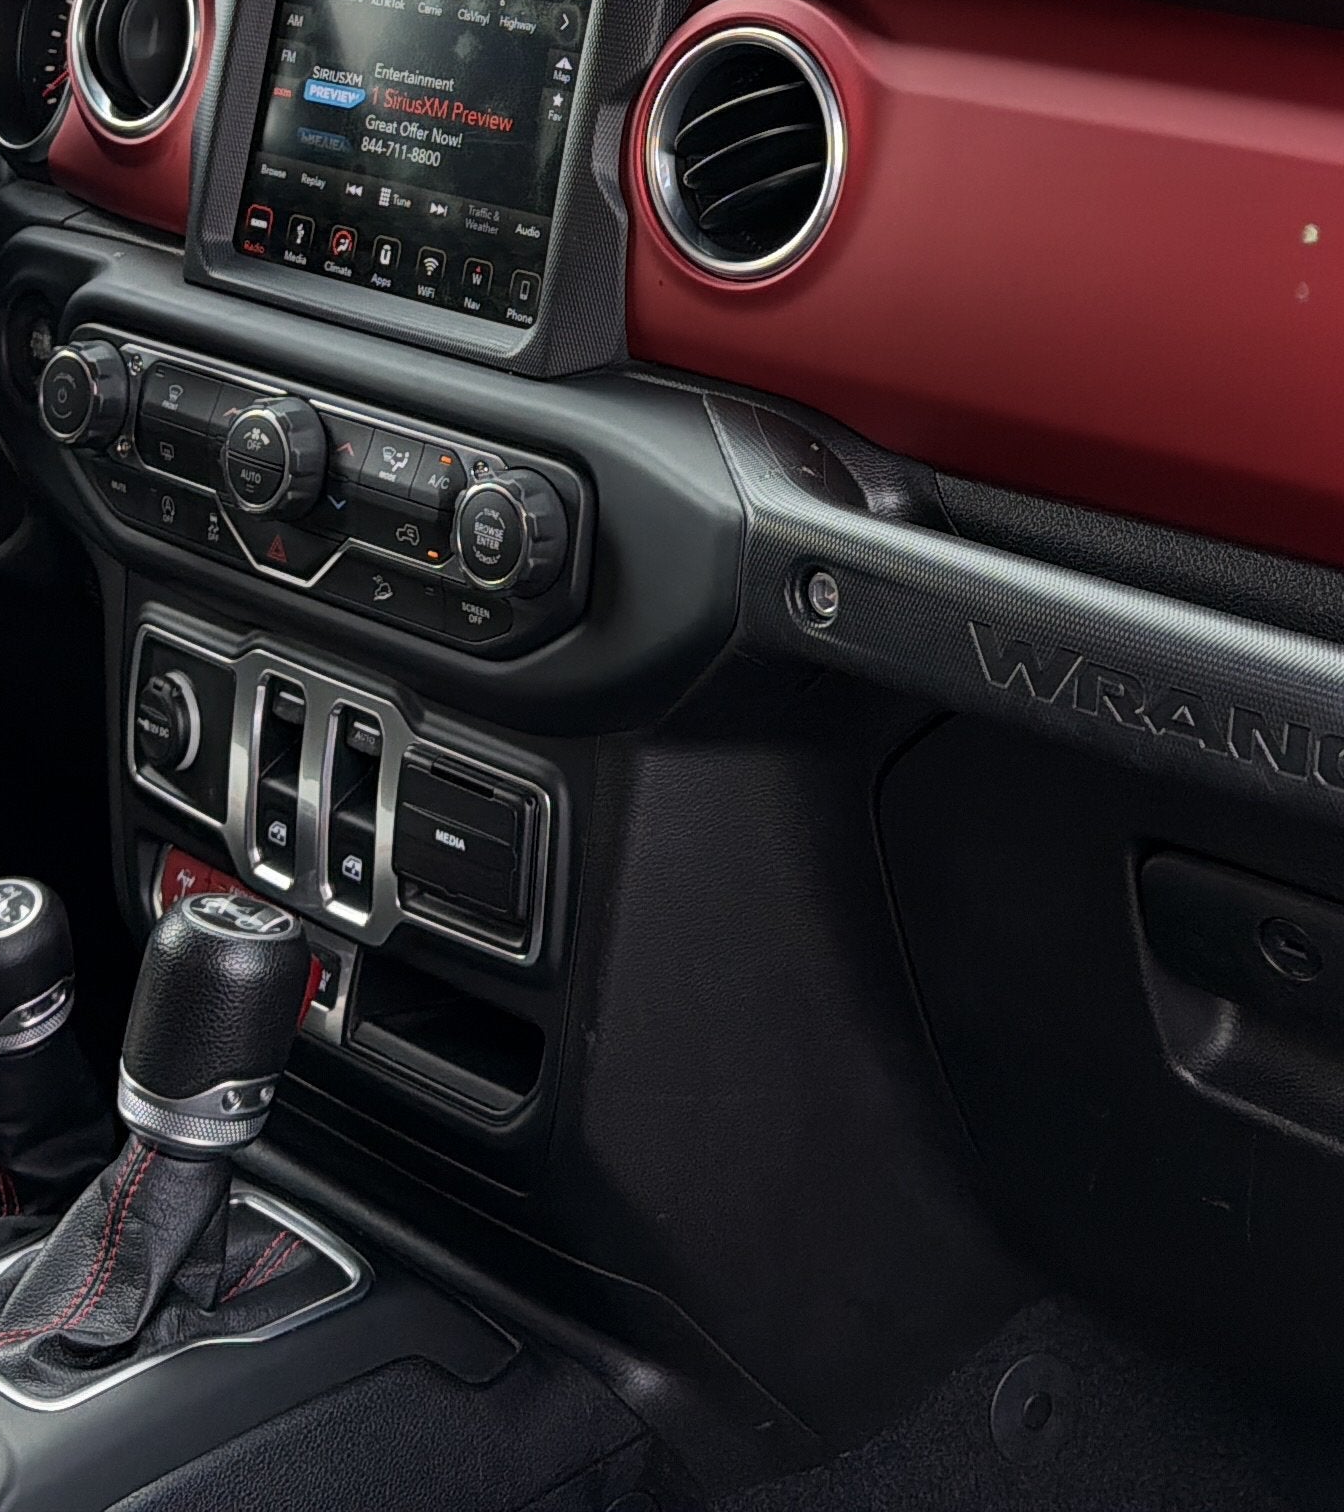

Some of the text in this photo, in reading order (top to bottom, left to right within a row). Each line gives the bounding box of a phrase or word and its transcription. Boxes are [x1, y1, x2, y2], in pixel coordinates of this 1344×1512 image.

[286, 14, 304, 28] AM
[499, 15, 536, 34] Highway
[281, 49, 296, 64] FM
[374, 62, 455, 92] Entertainment
[309, 85, 360, 104] PREVIEW
[383, 88, 448, 119] SiriusXM
[452, 102, 514, 132] Preview
[548, 110, 562, 122] Fav
[365, 114, 463, 148] Great Offer Now!
[361, 137, 441, 167] 844-711-8800
[301, 173, 326, 190] Replay
[393, 193, 411, 208] Tune
[468, 204, 500, 221] Traffic &
[465, 218, 498, 235] Weather
[515, 224, 540, 238] Audio
[284, 250, 306, 265] Media
[324, 261, 352, 277] Climate
[371, 273, 391, 288] Apps
[464, 297, 481, 311] Nav
[506, 308, 533, 325] Phone
[247, 439, 261, 451] OFF
[240, 469, 261, 484] AUTO
[428, 474, 450, 489] A/C
[474, 521, 504, 539] BROWSE
[477, 534, 500, 550] ENTER
[462, 602, 490, 619] SCREEN
[469, 614, 482, 625] OFF
[436, 829, 465, 852] MEDIA
